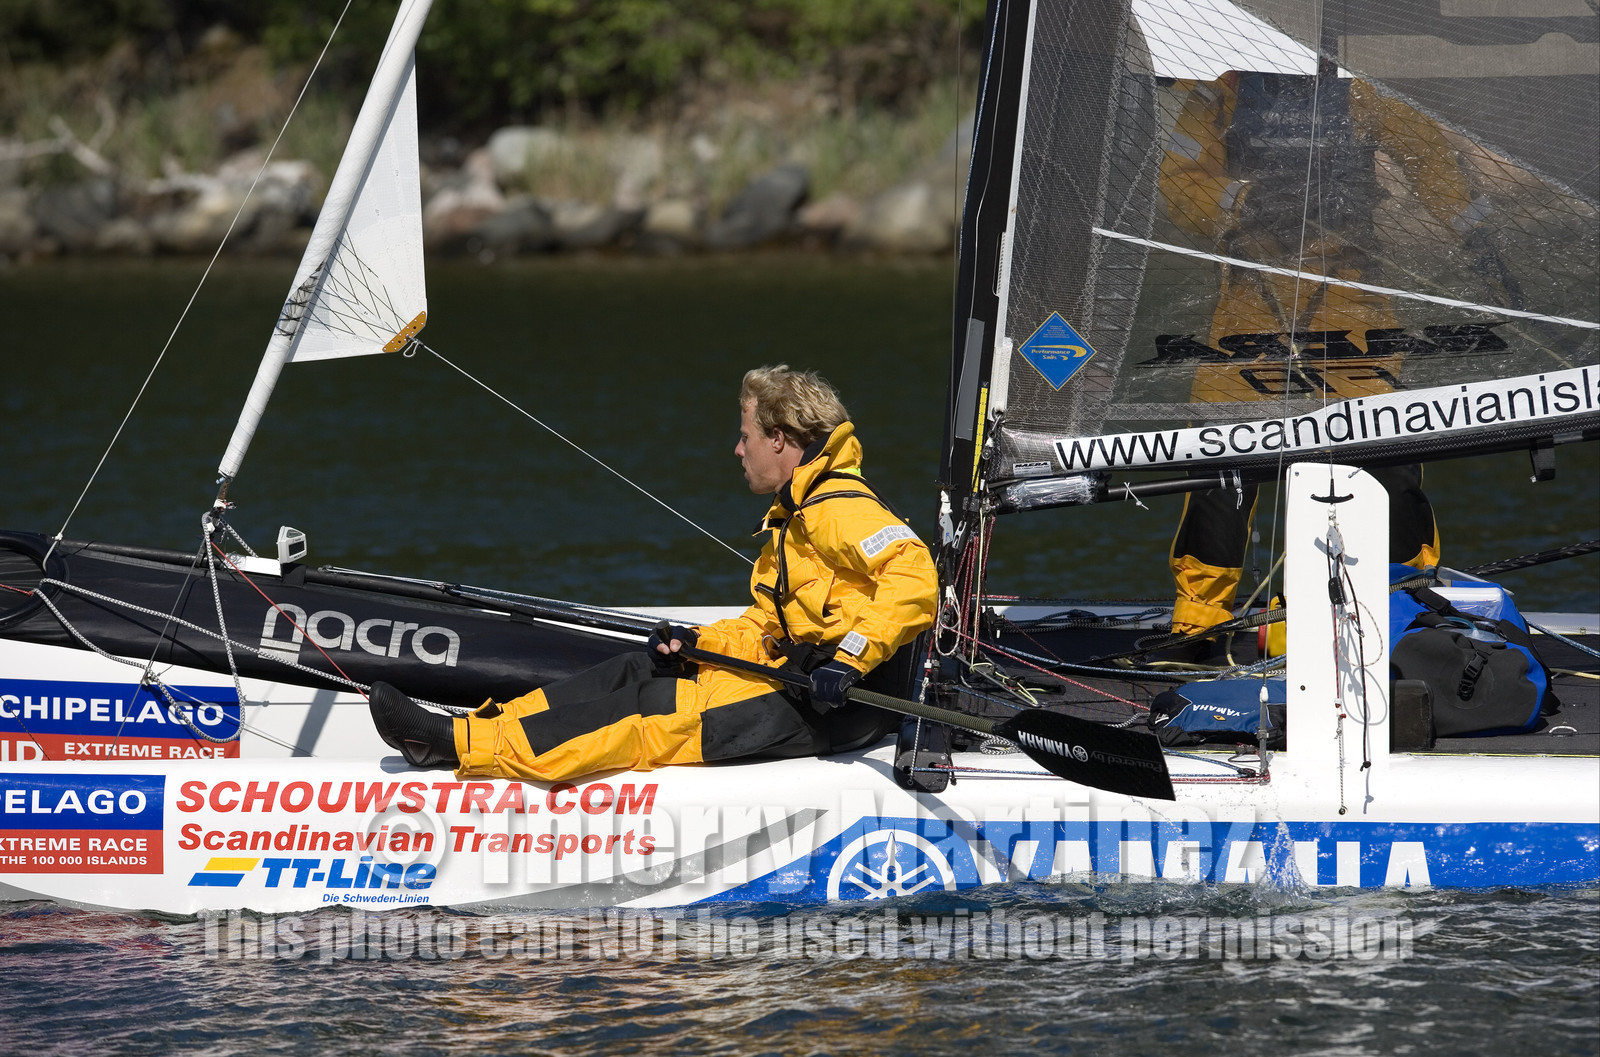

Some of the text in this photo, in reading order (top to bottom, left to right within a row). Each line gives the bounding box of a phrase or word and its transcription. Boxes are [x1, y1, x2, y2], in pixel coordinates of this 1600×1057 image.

[1055, 368, 1600, 471] www.scandinavianisl
[257, 603, 461, 667] nacra
[0, 694, 224, 727] CHIPELAGO
[1192, 704, 1241, 717] YAMAHA
[63, 741, 225, 760] EXTREME RACE
[1018, 730, 1163, 773] Powered by YAMAHA
[0, 790, 148, 815] ELAGO
[176, 780, 659, 815] SCHOUWSTRA.COM
[88, 838, 148, 852] RACE
[178, 823, 657, 860] Scandinavian Transports
[0, 856, 148, 866] THE 100 000 ISLANDS
[261, 855, 438, 890] TT-Line
[322, 893, 430, 904] Die Schweden-Linien
